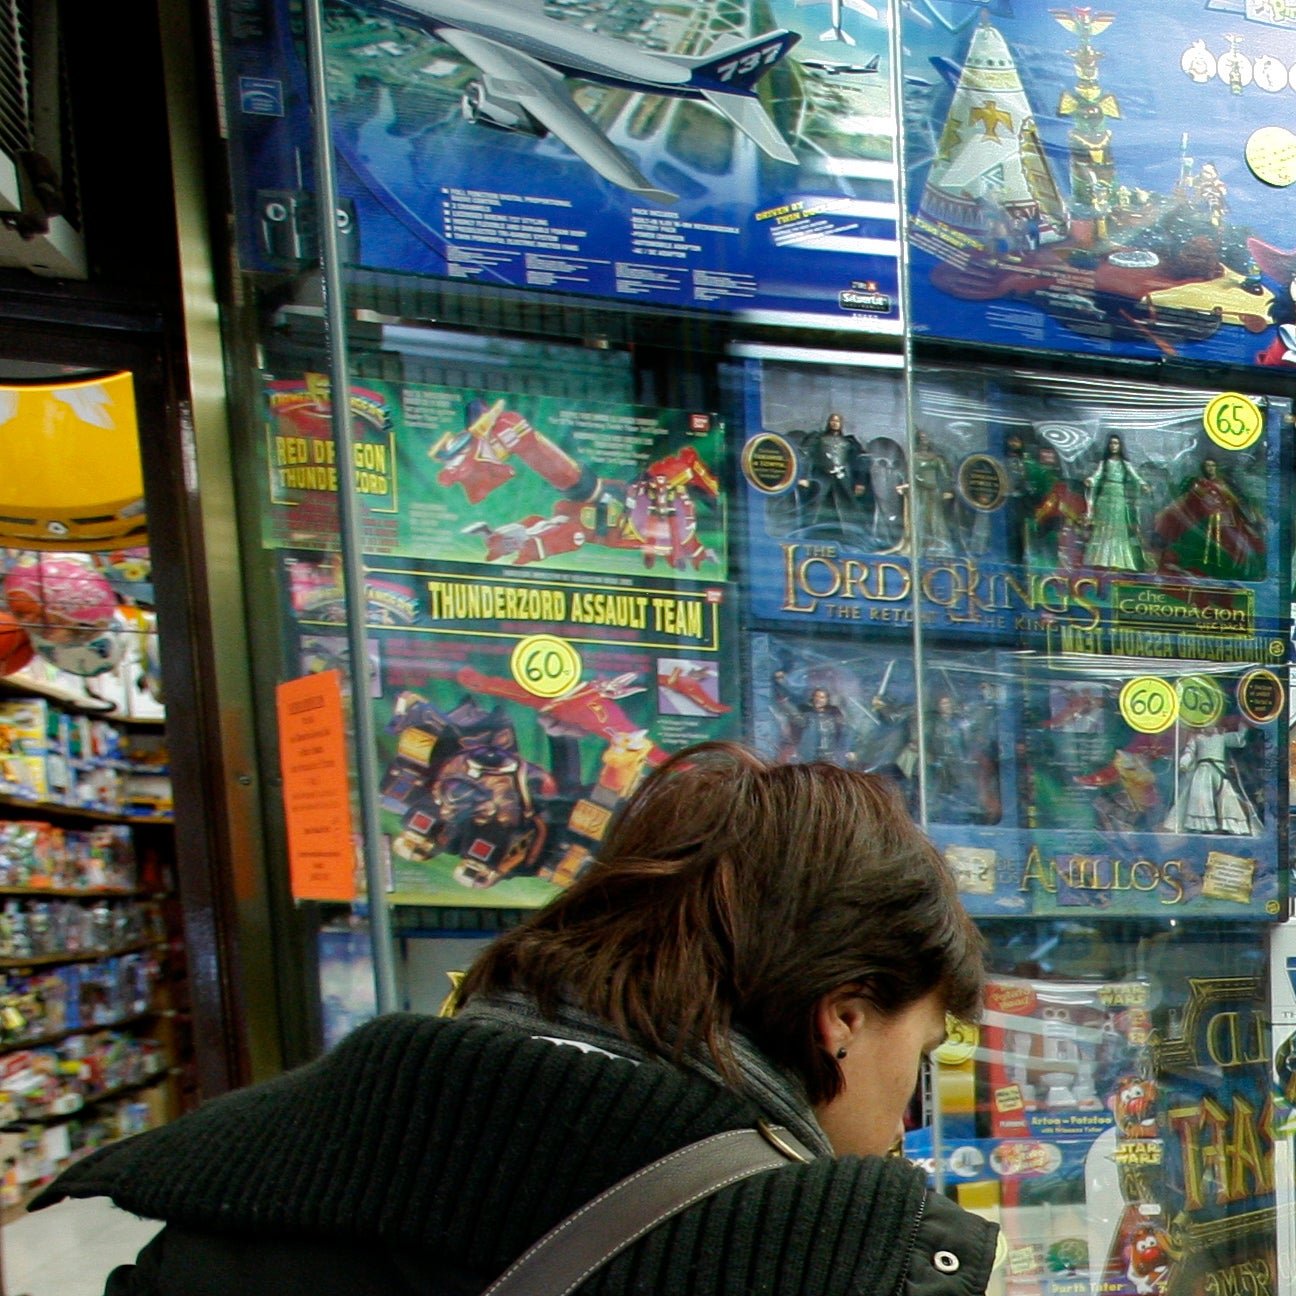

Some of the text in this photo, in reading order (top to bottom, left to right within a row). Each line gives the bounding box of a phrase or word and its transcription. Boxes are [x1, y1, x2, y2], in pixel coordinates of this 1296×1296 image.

[717, 43, 779, 81] 737
[276, 437, 307, 464] RED
[805, 544, 836, 560] THE
[781, 543, 911, 613] LORD
[428, 581, 702, 639] THUNDERZORD ASSAULT TEAM
